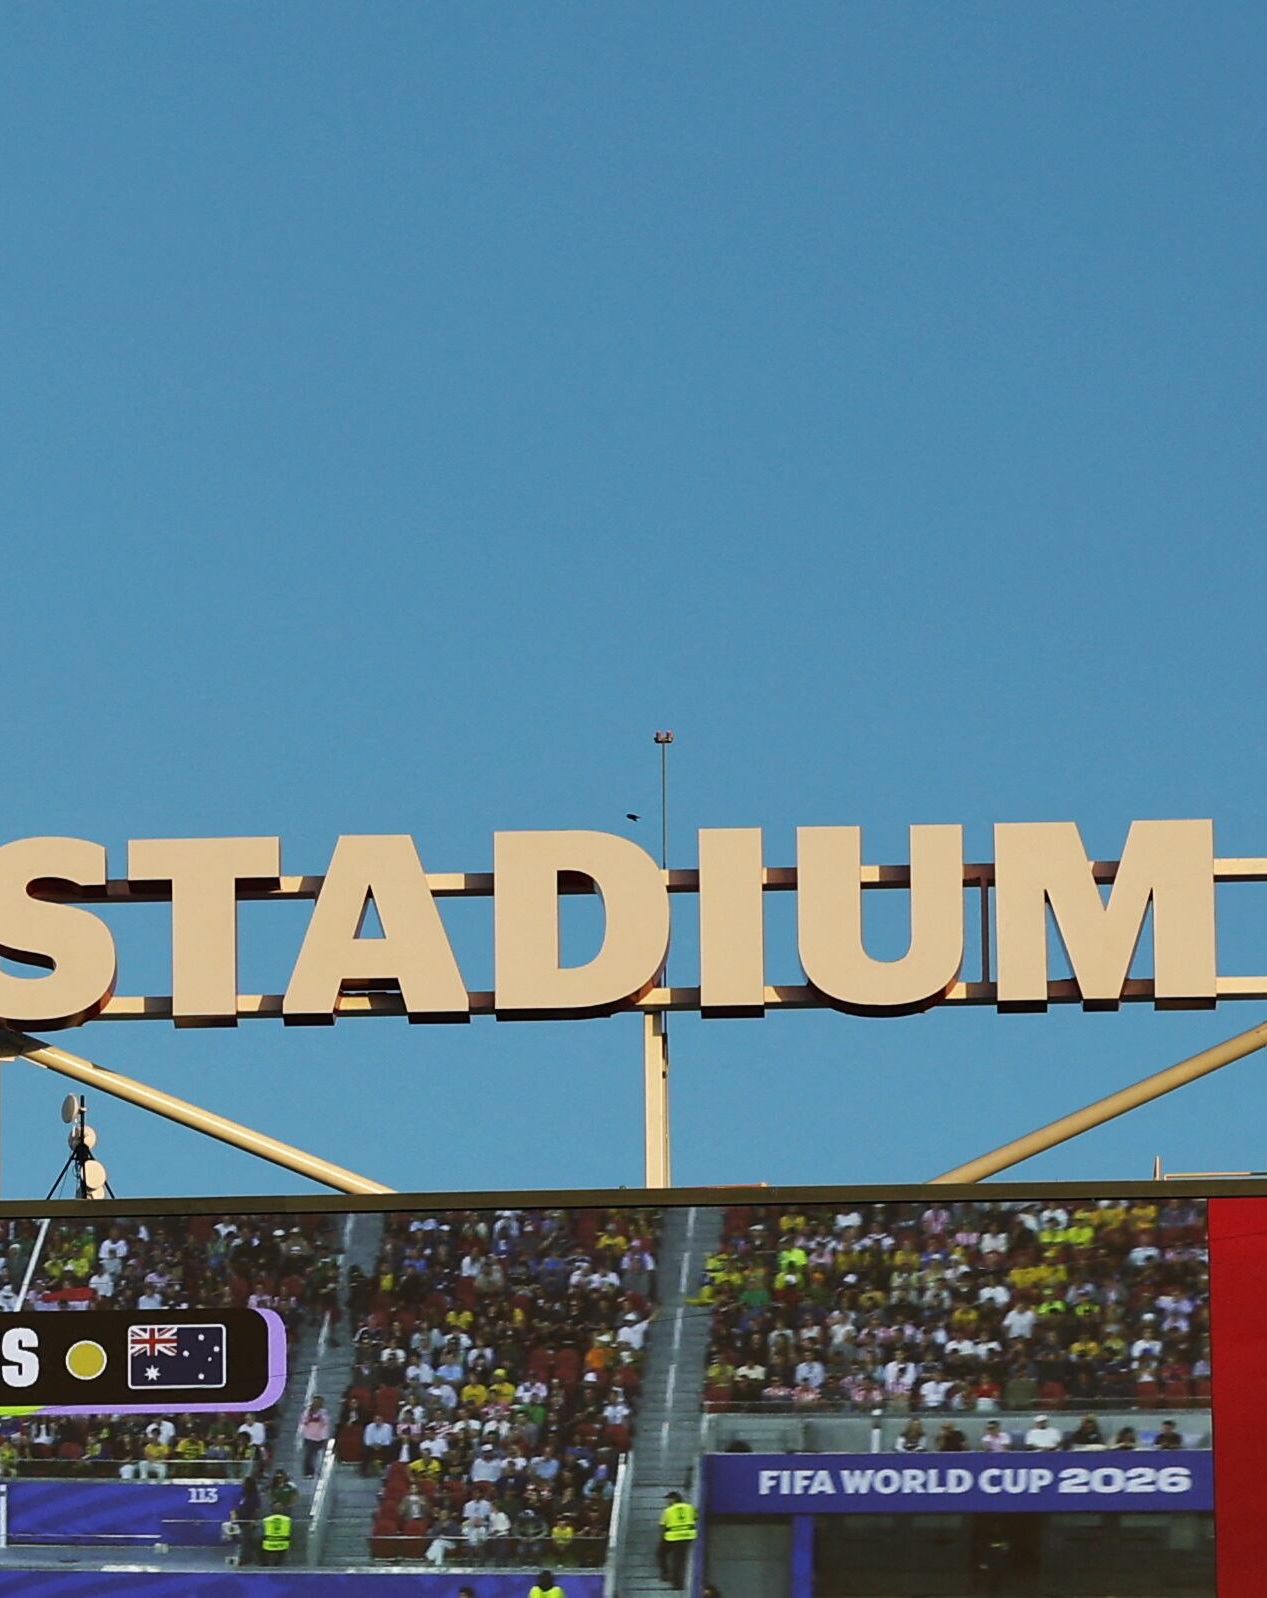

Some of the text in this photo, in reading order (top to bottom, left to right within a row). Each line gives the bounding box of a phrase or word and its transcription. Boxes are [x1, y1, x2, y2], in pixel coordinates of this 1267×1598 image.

[758, 1467, 1192, 1495] FIFA WORLD CUP 2026
[187, 1487, 219, 1503] 113
